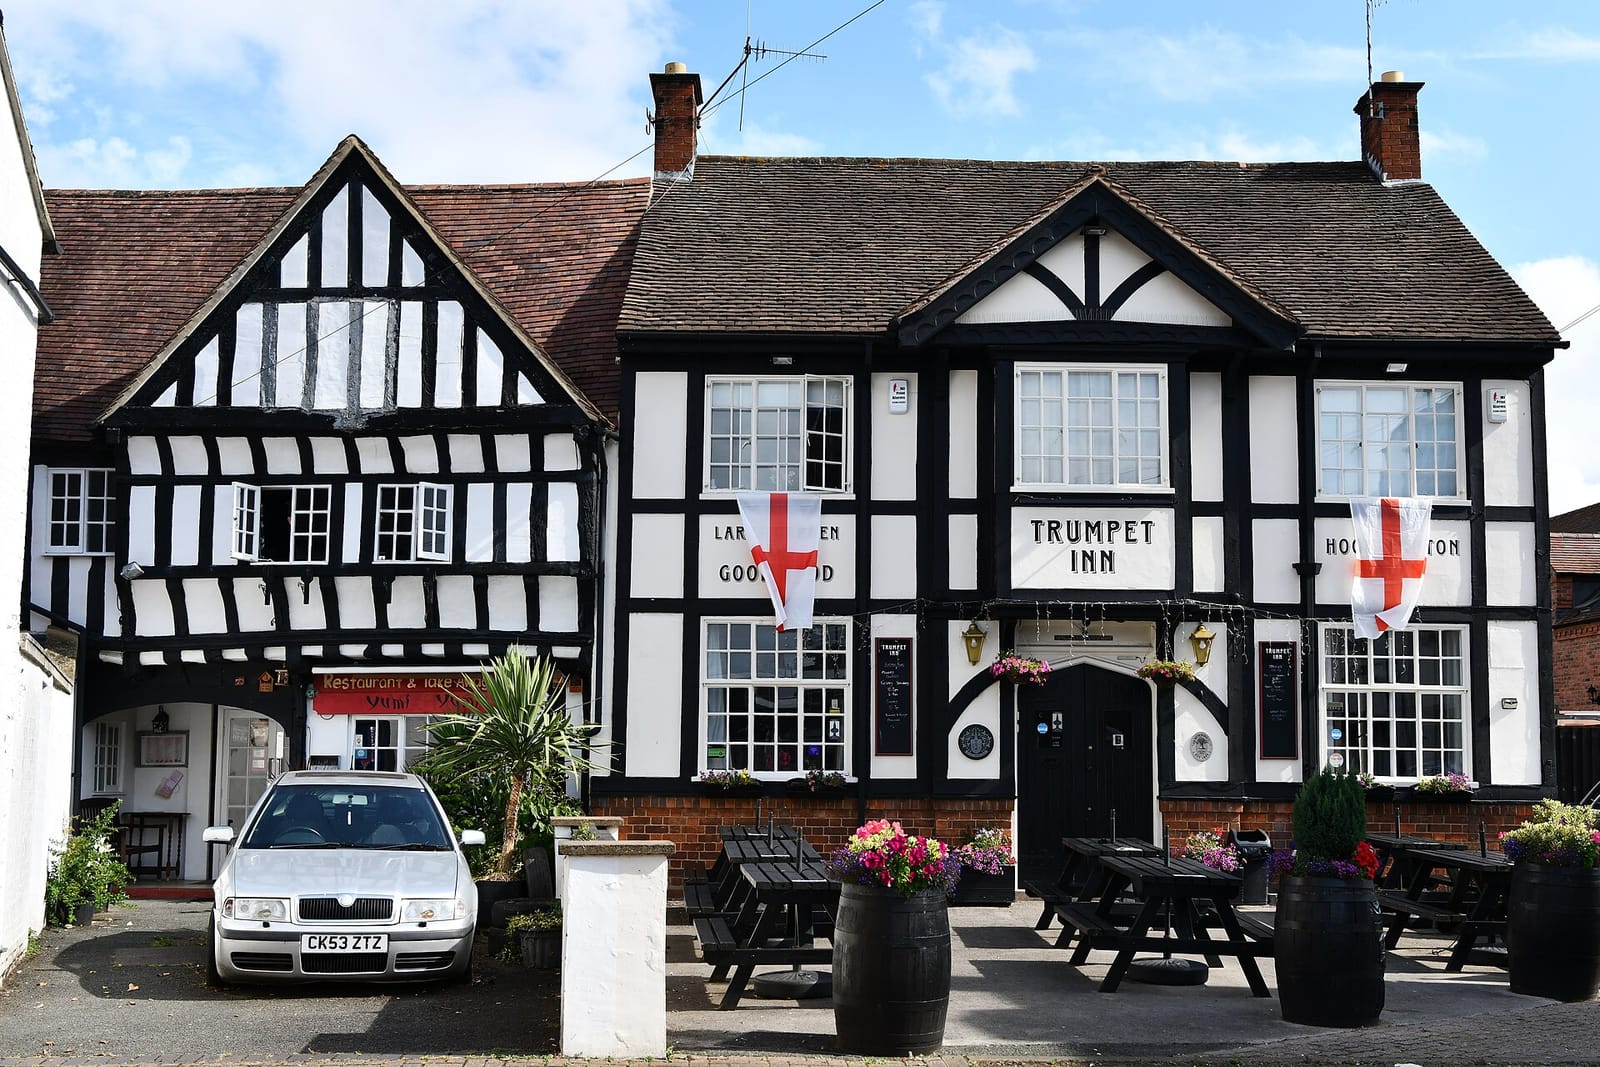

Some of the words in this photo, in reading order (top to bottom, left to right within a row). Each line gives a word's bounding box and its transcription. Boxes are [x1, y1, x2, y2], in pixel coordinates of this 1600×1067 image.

[714, 526, 747, 540] LAR
[1030, 519, 1156, 545] TRUMPET
[1070, 549, 1116, 574] INN
[720, 565, 765, 582] GOO
[323, 674, 402, 689] Restaurant
[406, 678, 417, 689] &
[308, 935, 348, 950] CK53
[352, 935, 382, 950] ZTZ
